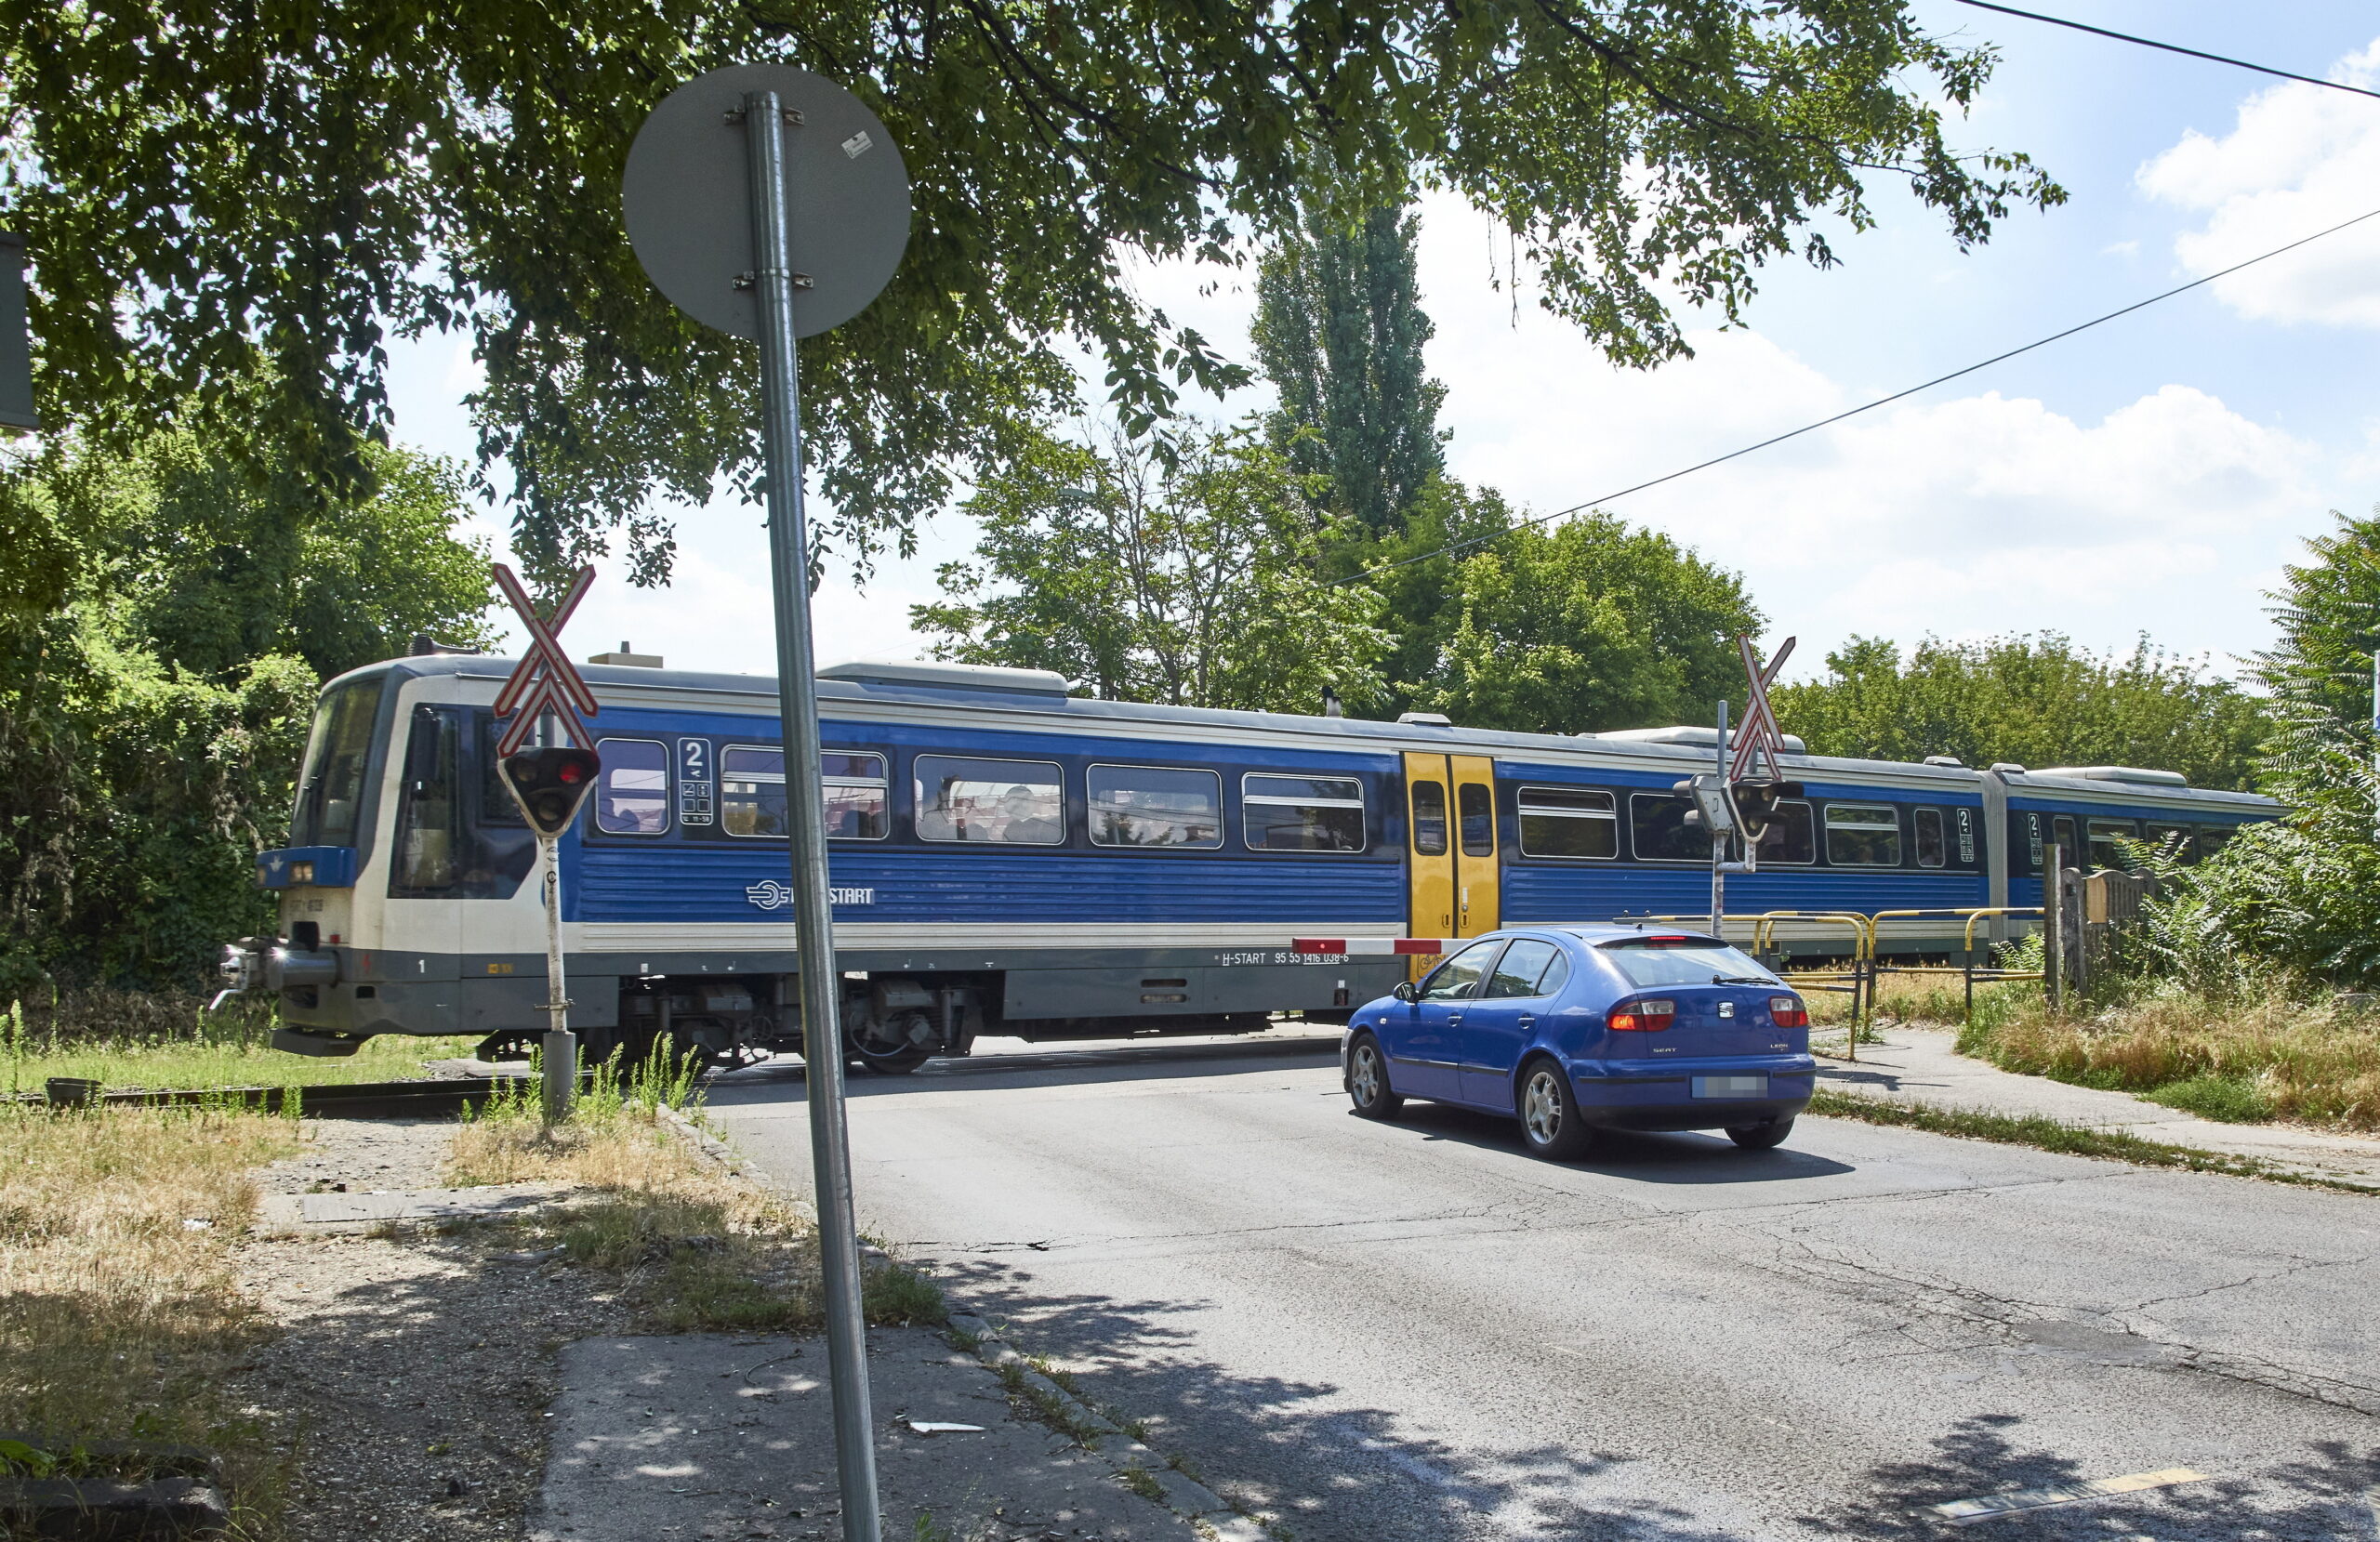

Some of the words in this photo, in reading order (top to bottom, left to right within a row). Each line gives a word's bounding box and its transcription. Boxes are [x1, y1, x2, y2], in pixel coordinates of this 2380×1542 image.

[686, 742, 703, 766] 2
[1961, 811, 1968, 826] 2
[2030, 816, 2038, 831] 2
[418, 960, 425, 973] 1
[1223, 953, 1265, 966] H-START
[1275, 953, 1286, 963] 95
[1289, 953, 1301, 963] 55
